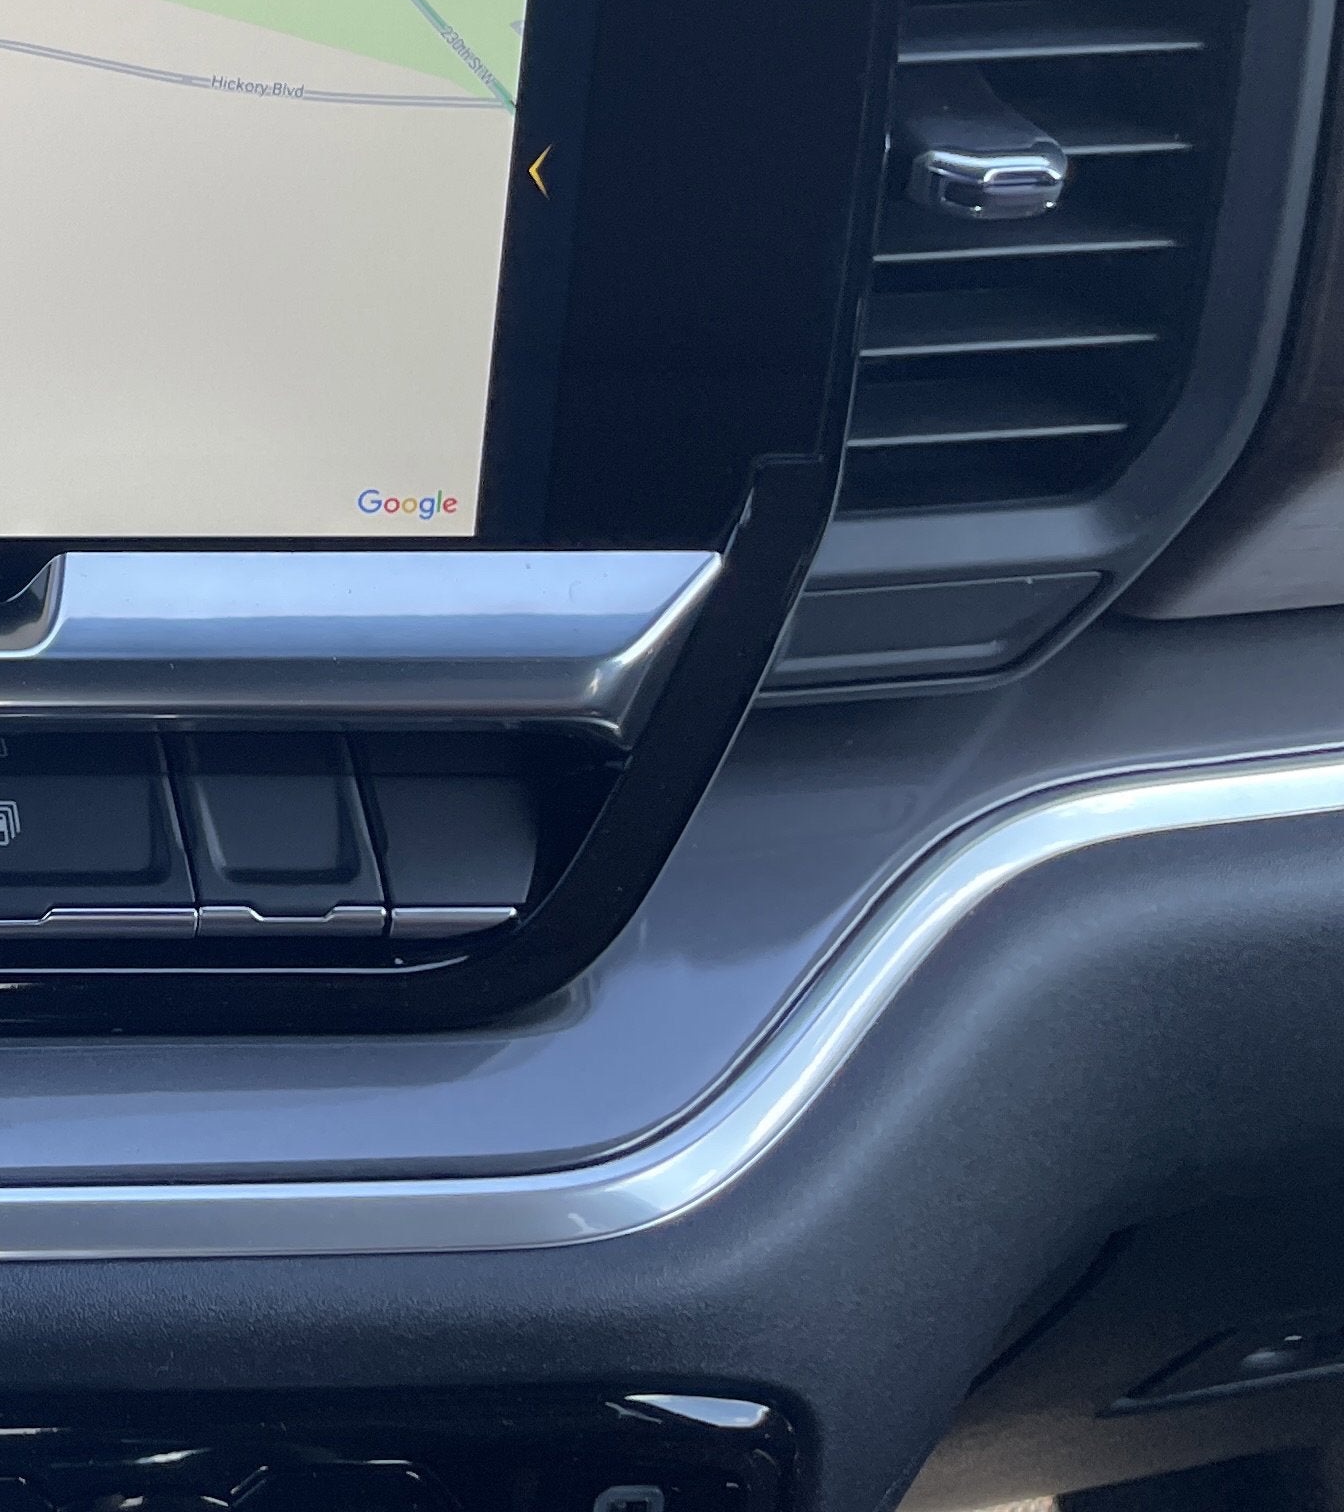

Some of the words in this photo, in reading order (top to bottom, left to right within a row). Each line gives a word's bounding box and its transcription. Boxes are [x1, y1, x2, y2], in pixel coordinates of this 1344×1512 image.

[211, 74, 269, 98] Hickory
[271, 82, 305, 98] Blvd
[357, 488, 458, 521] Google
